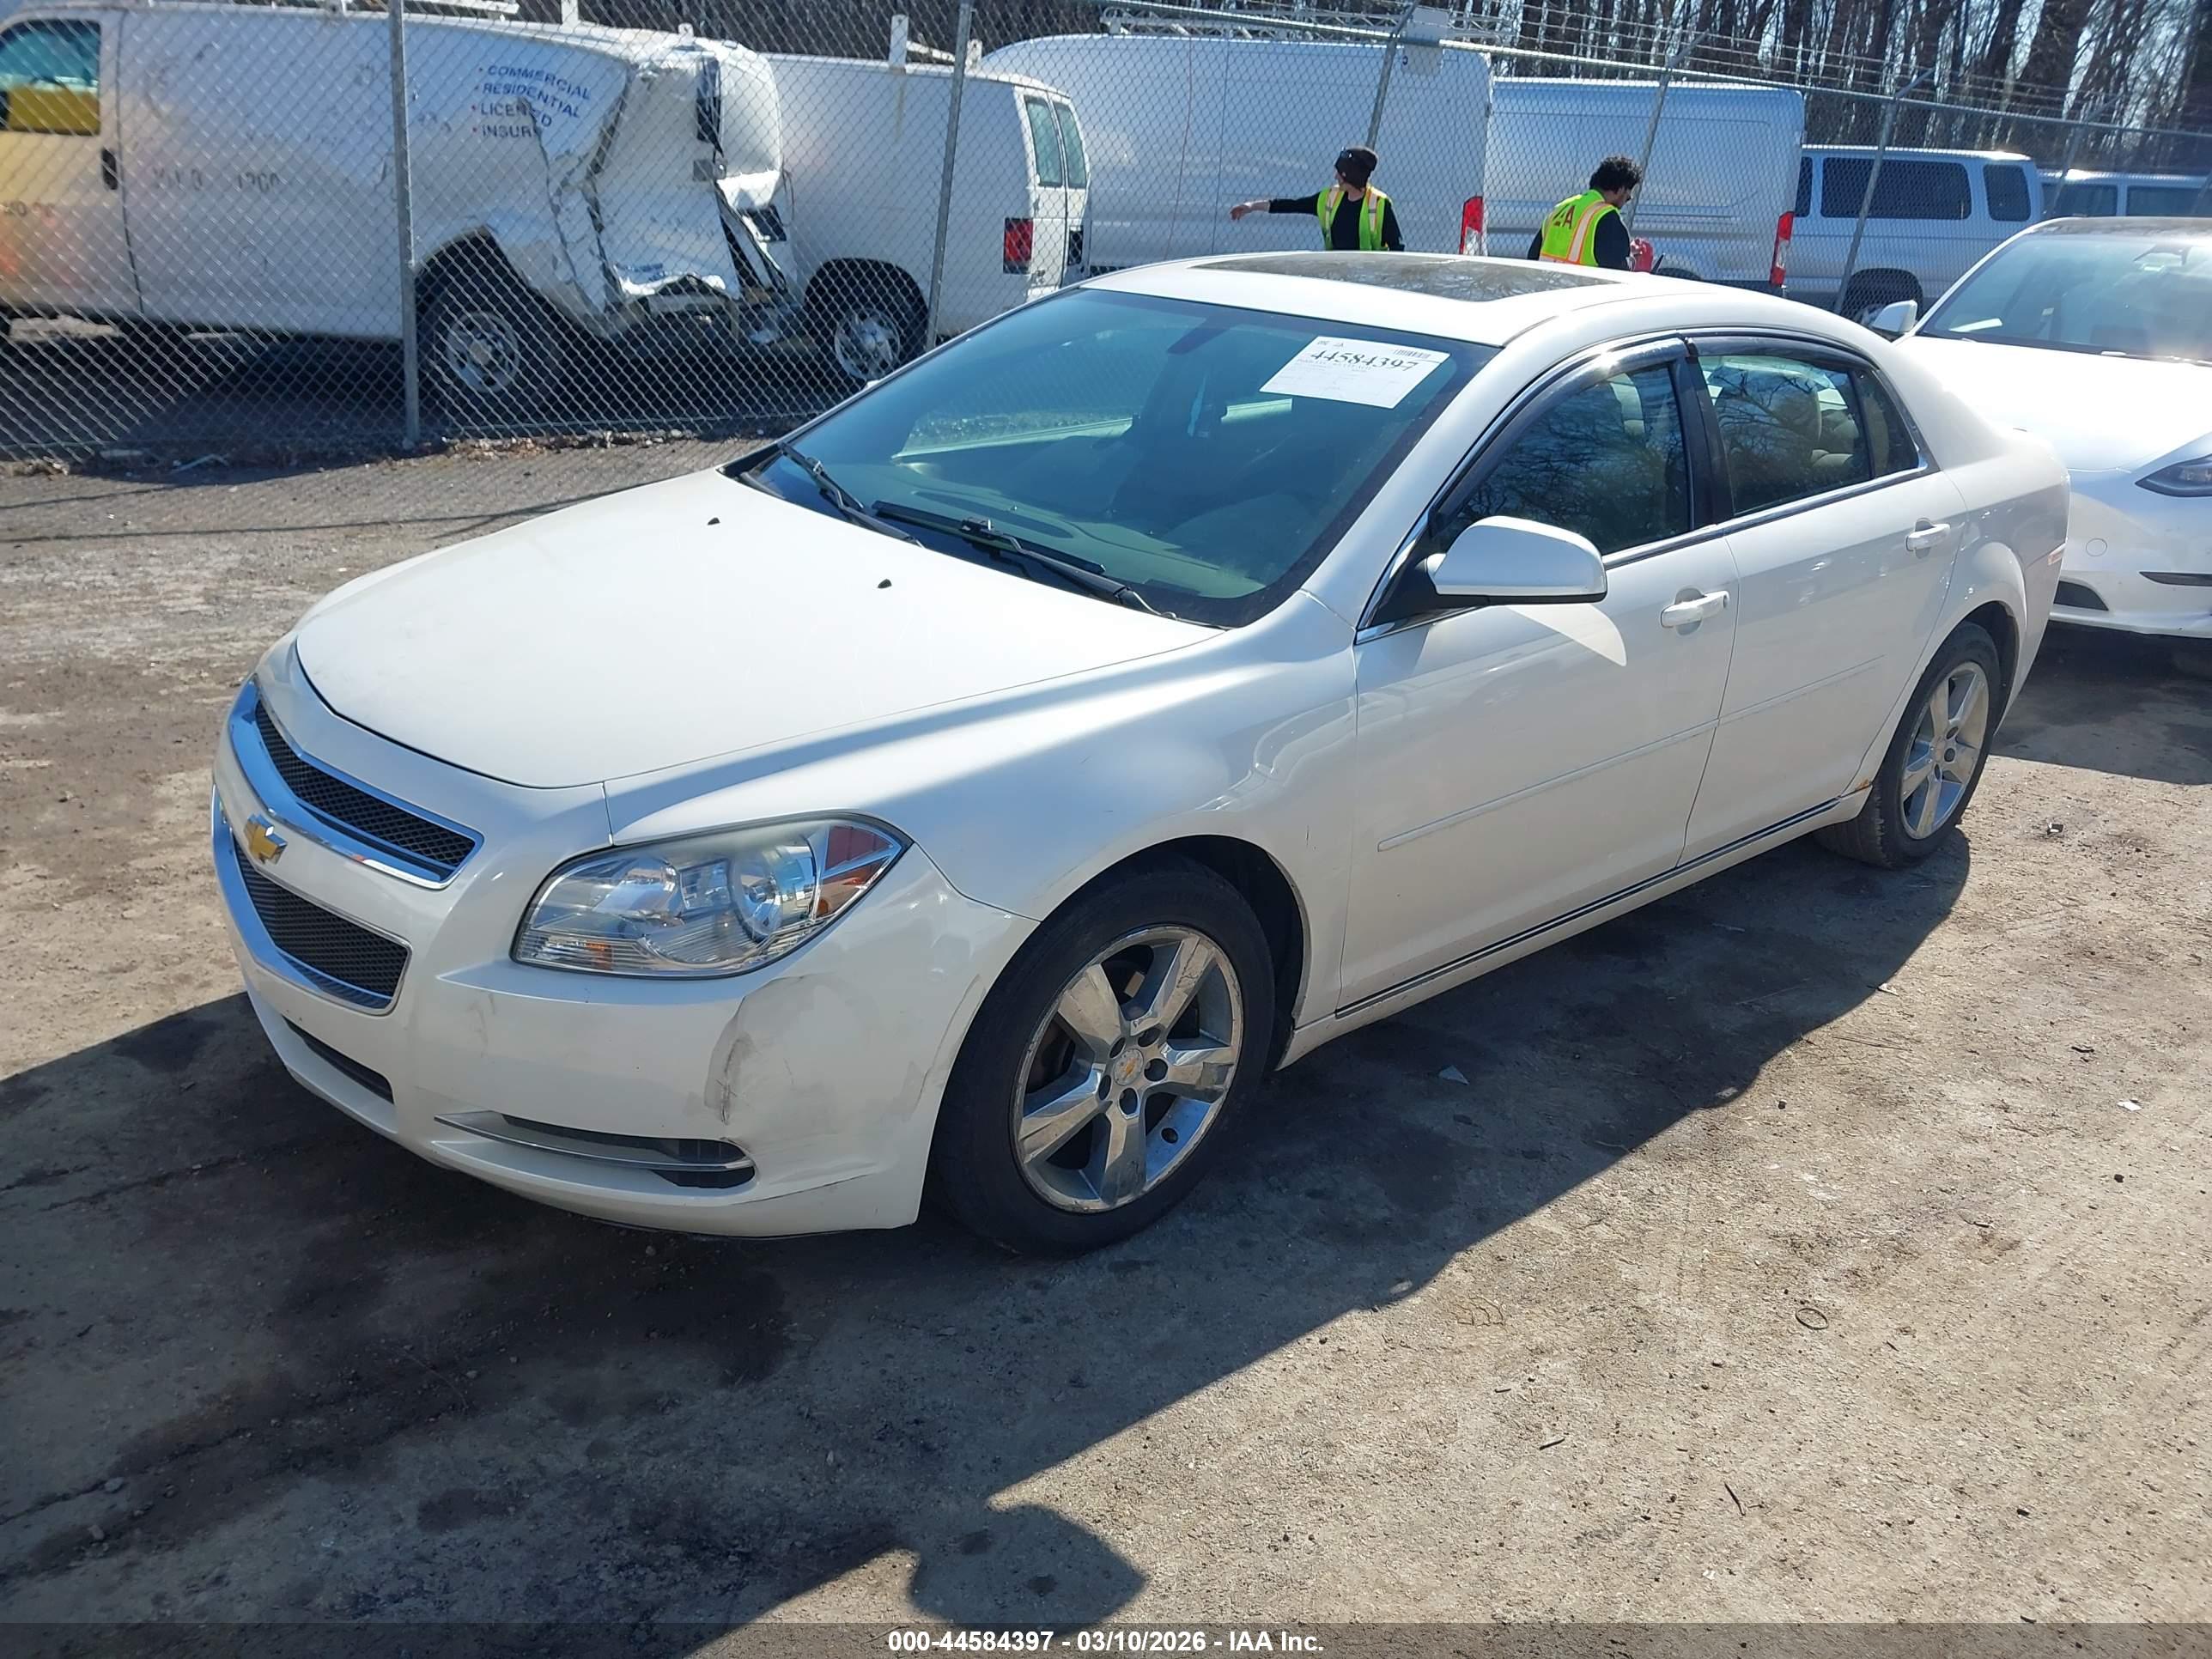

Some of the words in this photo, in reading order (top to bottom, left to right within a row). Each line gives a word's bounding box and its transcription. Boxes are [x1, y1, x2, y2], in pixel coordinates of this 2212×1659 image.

[488, 64, 591, 100] COMMERCIAL
[480, 102, 552, 127] LICEND
[483, 82, 581, 118] RESIDENTIAL
[1310, 349, 1419, 371] 44584397
